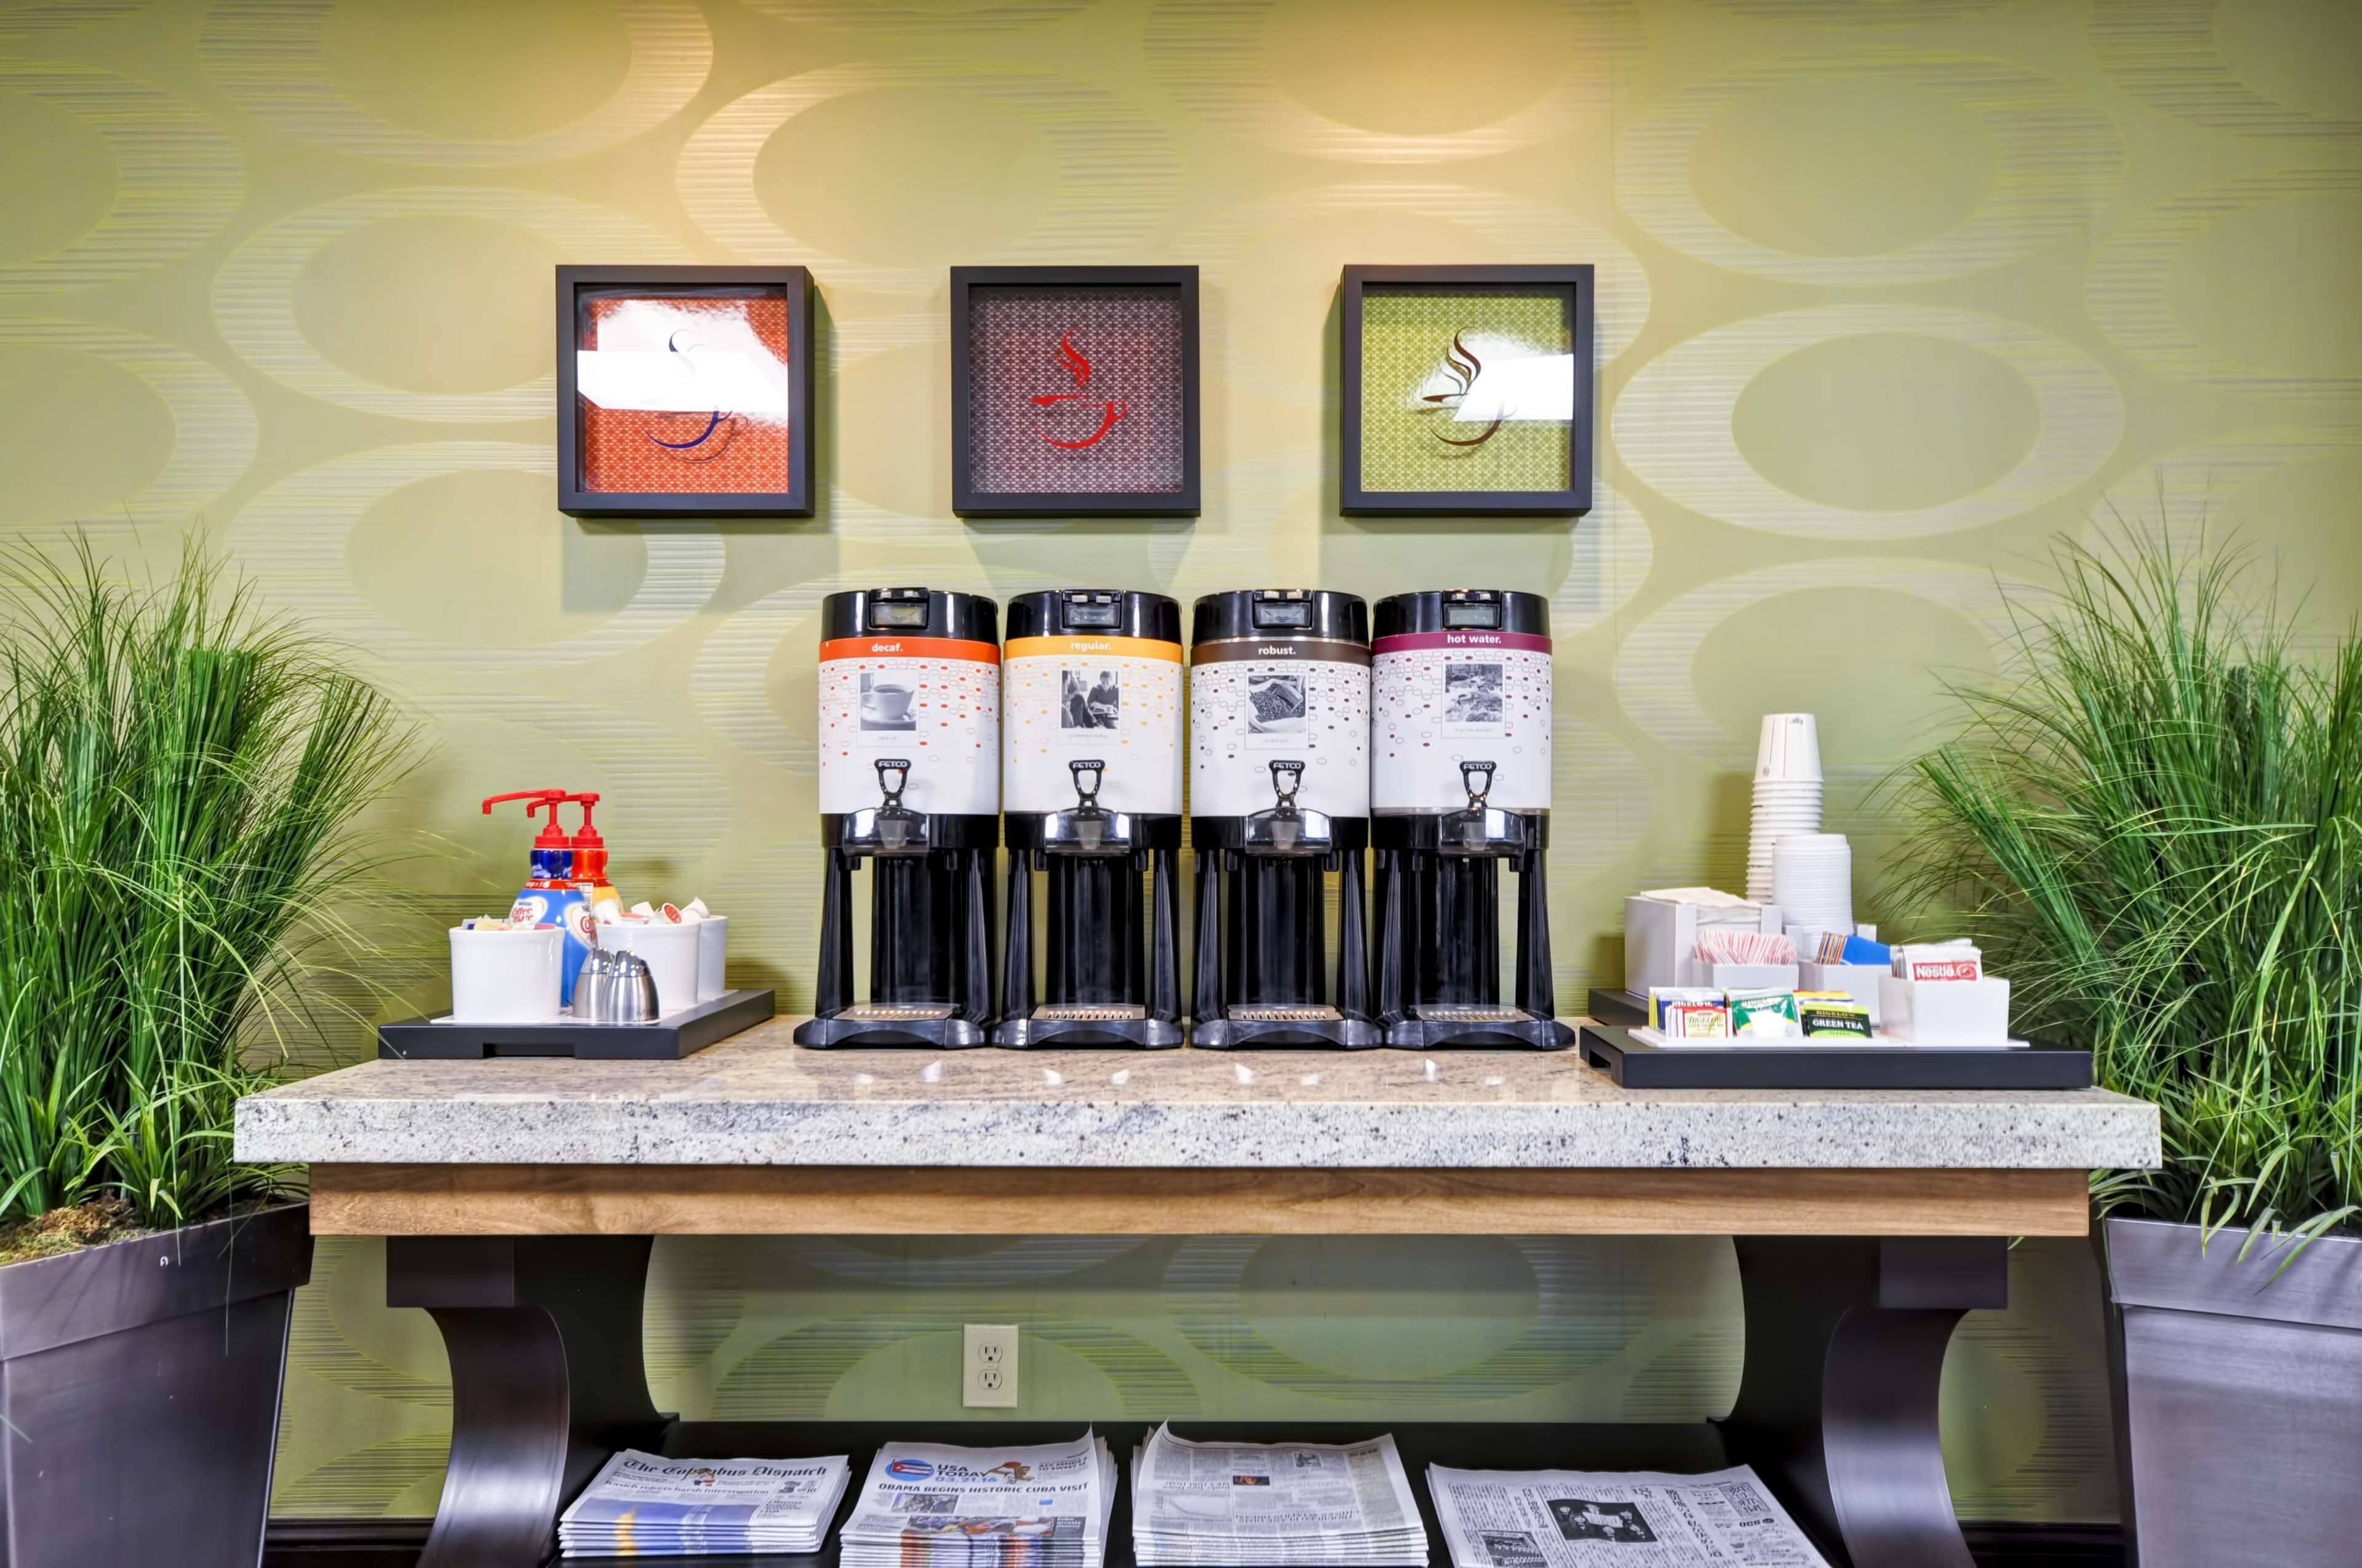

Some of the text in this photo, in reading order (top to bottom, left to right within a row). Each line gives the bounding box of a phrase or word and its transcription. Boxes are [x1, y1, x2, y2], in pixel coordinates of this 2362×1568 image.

[1446, 634, 1502, 644] hot water.
[871, 643, 904, 652] decaf.
[1070, 641, 1111, 652] regular.
[1258, 645, 1296, 655] robust.
[1812, 1019, 1864, 1031] GREEN TEA
[624, 1459, 659, 1473] The
[752, 1467, 827, 1478] Dispatch
[879, 1483, 920, 1492] OBAMA
[1059, 1482, 1089, 1492] VISIT
